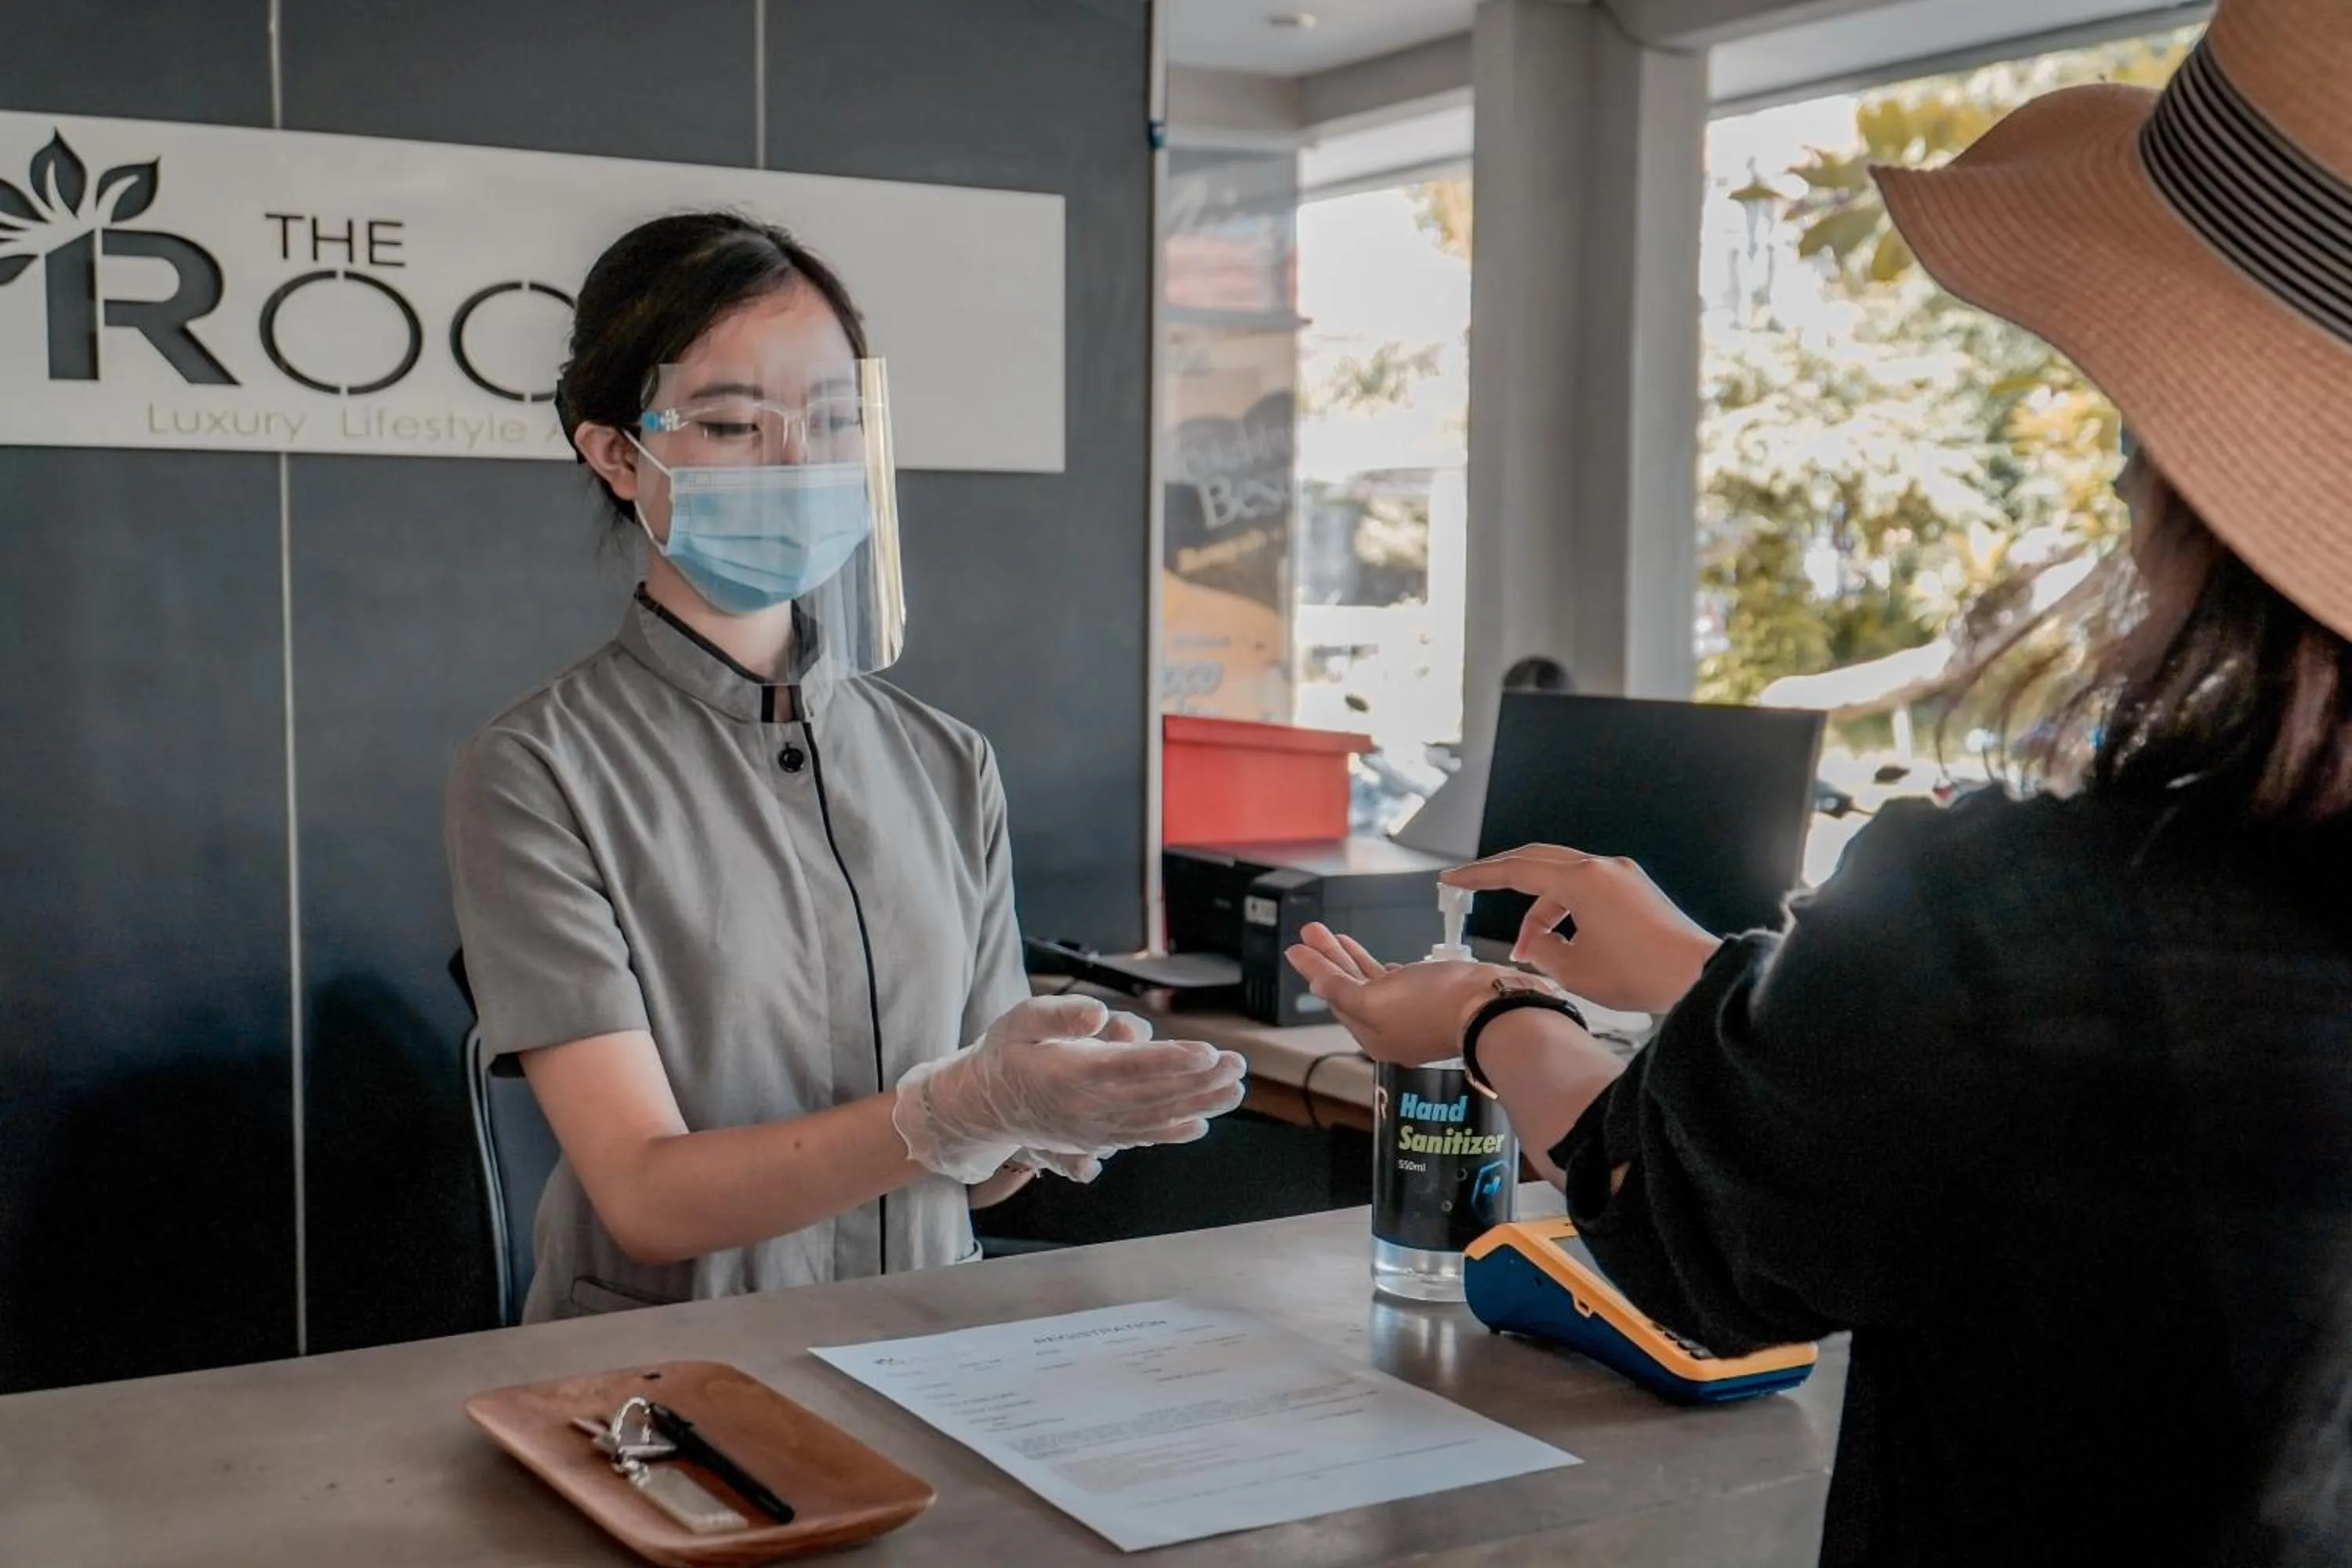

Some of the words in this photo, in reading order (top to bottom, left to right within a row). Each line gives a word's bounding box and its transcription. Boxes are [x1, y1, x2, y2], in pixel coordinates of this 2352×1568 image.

[264, 212, 406, 267] THE
[45, 227, 579, 403] ROO
[147, 402, 307, 442] Luxury
[342, 406, 526, 449] Lifestyle
[1400, 1092, 1468, 1122] Hand
[1399, 1125, 1505, 1155] Sanitizer
[1033, 1319, 1168, 1345] REGISTRATION
